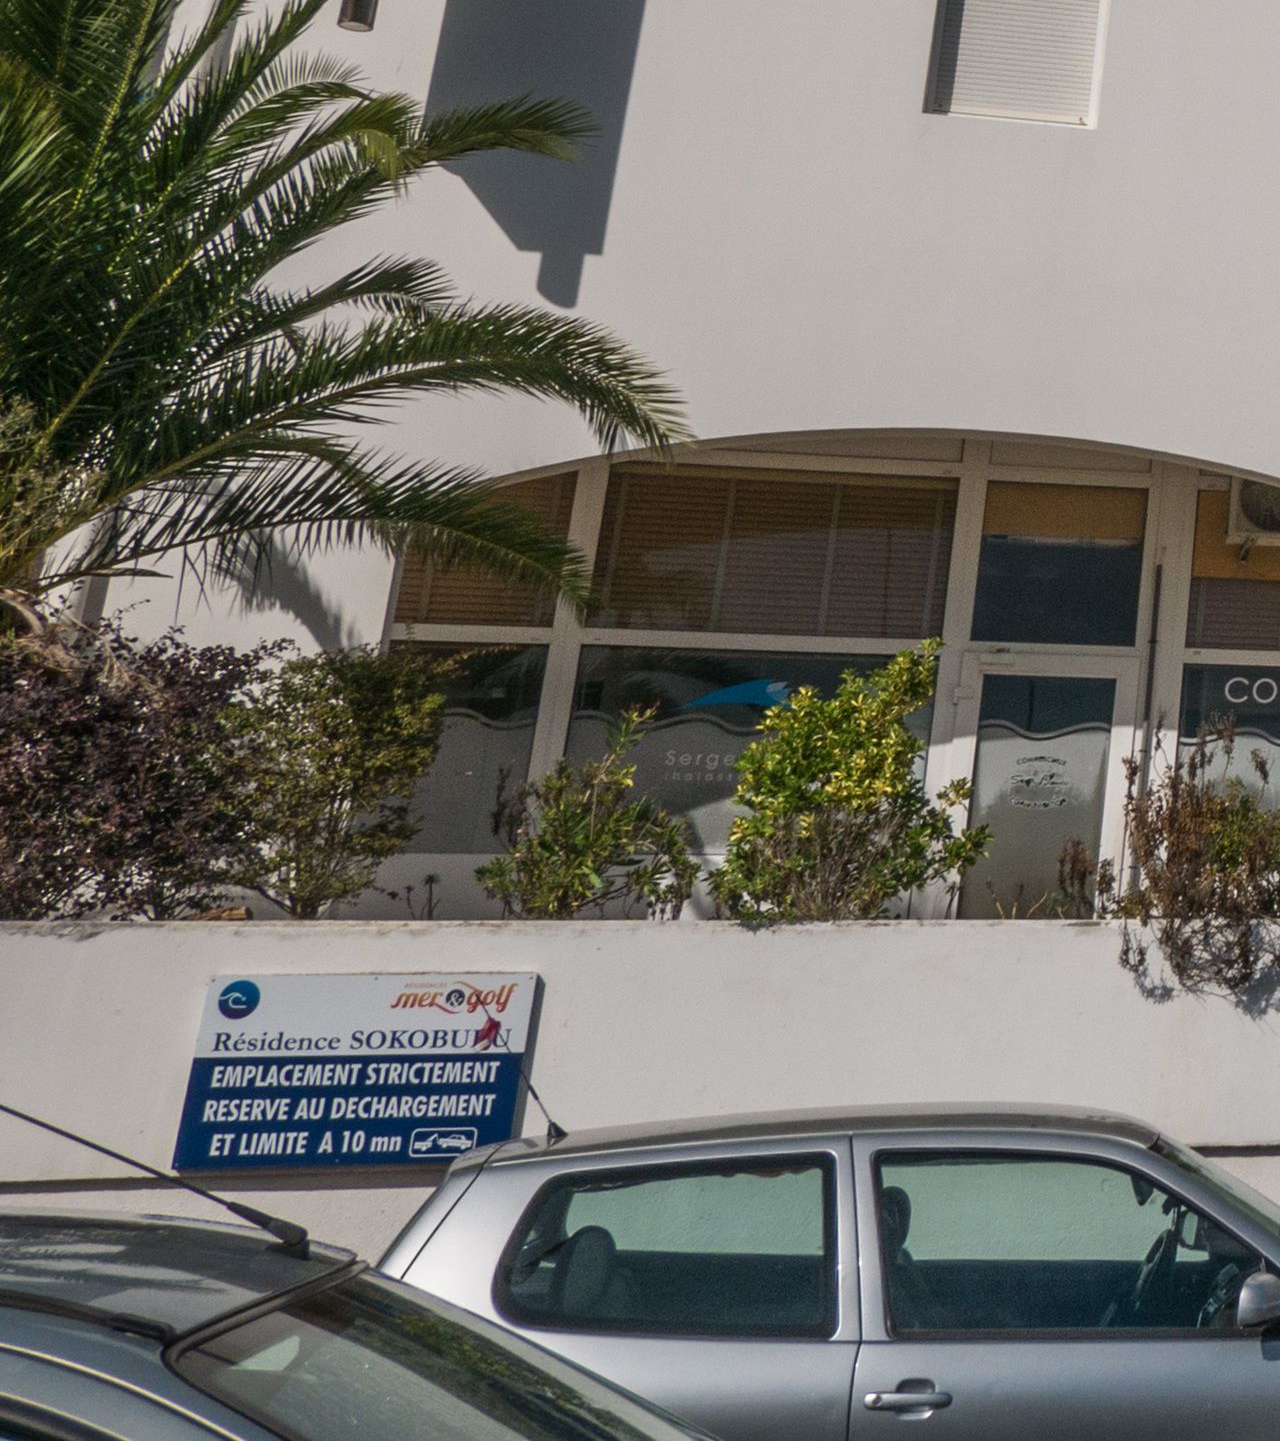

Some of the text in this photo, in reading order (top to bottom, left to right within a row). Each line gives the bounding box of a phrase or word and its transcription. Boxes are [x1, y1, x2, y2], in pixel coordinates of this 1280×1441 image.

[665, 750, 735, 770] Serge
[391, 991, 452, 1011] mer
[459, 982, 518, 1014] golf
[213, 1032, 341, 1052] Résidence
[211, 1061, 500, 1088] EMPLACEMENT STRICTEMENT
[203, 1094, 496, 1122] RESERVE AU DECHARGEMENT
[209, 1130, 402, 1156] ET LIMITE A 10 mn
